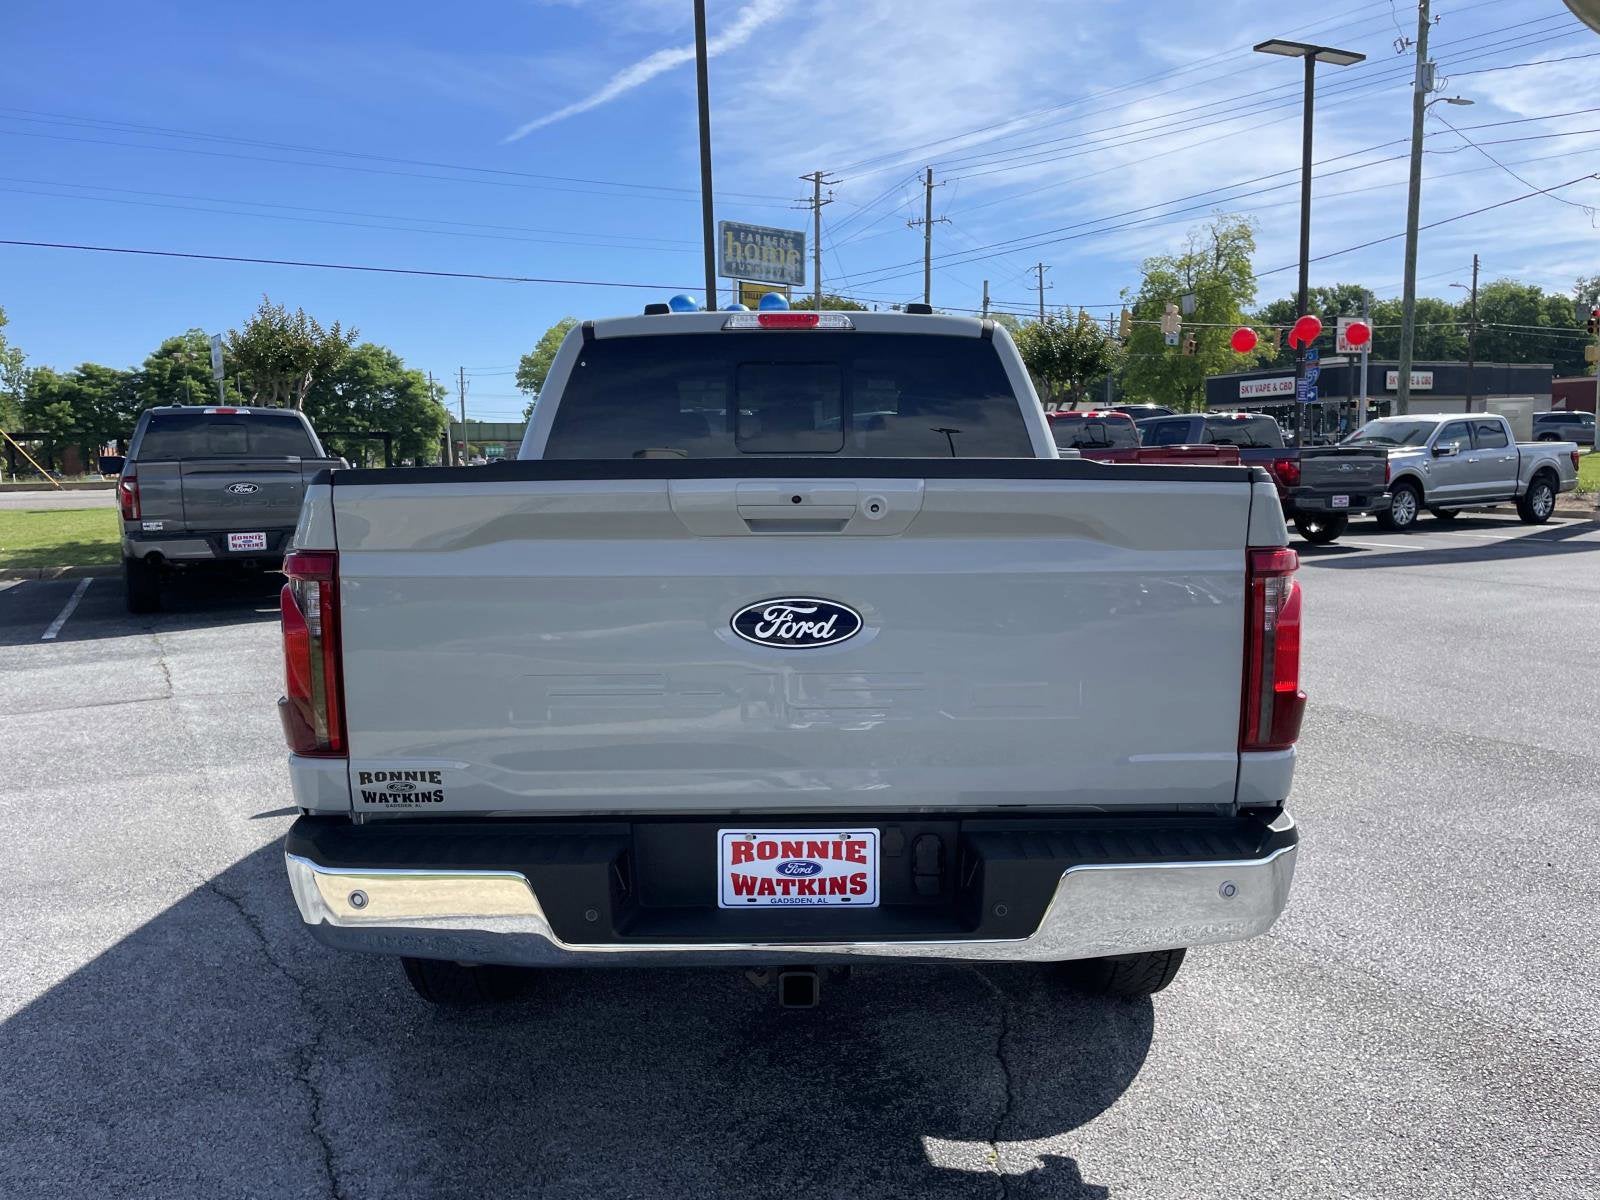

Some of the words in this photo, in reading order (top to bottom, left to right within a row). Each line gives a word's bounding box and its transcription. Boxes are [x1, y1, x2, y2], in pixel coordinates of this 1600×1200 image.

[725, 231, 801, 268] home
[1240, 385, 1253, 394] SKY
[1255, 383, 1271, 393] VAPE
[1273, 382, 1277, 392] &
[1279, 381, 1292, 391] CBD
[233, 483, 254, 494] Ford
[754, 605, 839, 639] Ford
[359, 770, 442, 785] RONNIE
[361, 789, 444, 803] WATKINS
[731, 840, 867, 865] RONNIE
[785, 863, 814, 874] Ford
[731, 872, 868, 896] WATKINS
